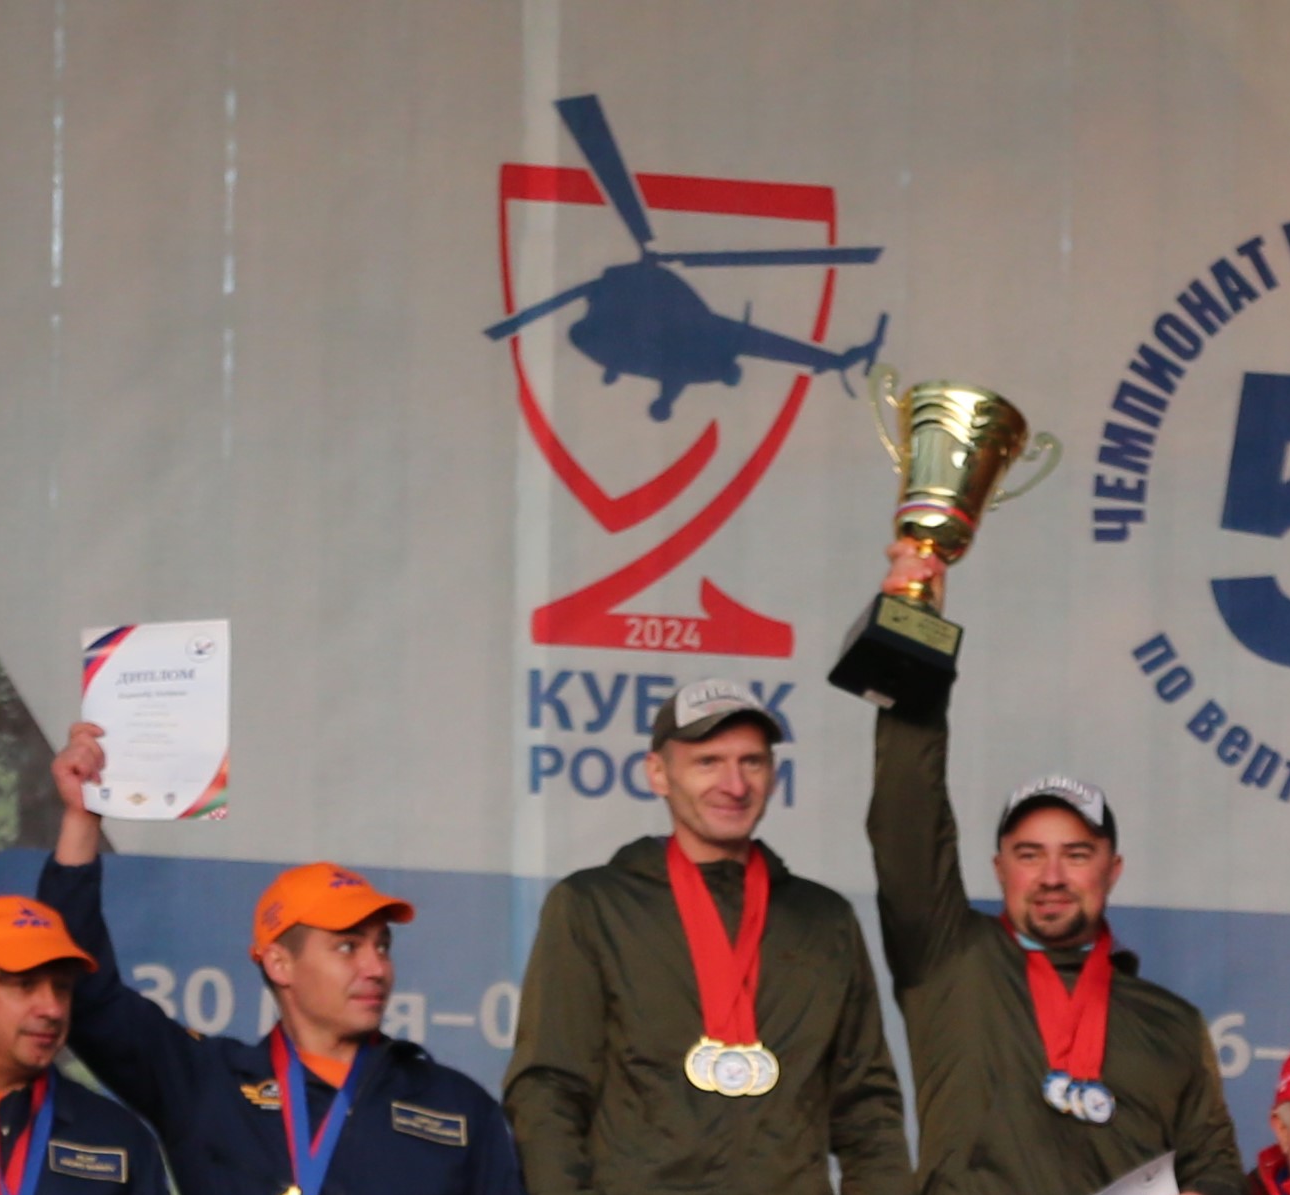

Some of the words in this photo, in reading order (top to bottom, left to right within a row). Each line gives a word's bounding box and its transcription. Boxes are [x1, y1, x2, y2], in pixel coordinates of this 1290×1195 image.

[1093, 236, 1280, 544] ЧЕМПИОНАТ
[624, 617, 702, 649] 2024
[1132, 633, 1195, 705] по
[527, 668, 796, 744] КУБК
